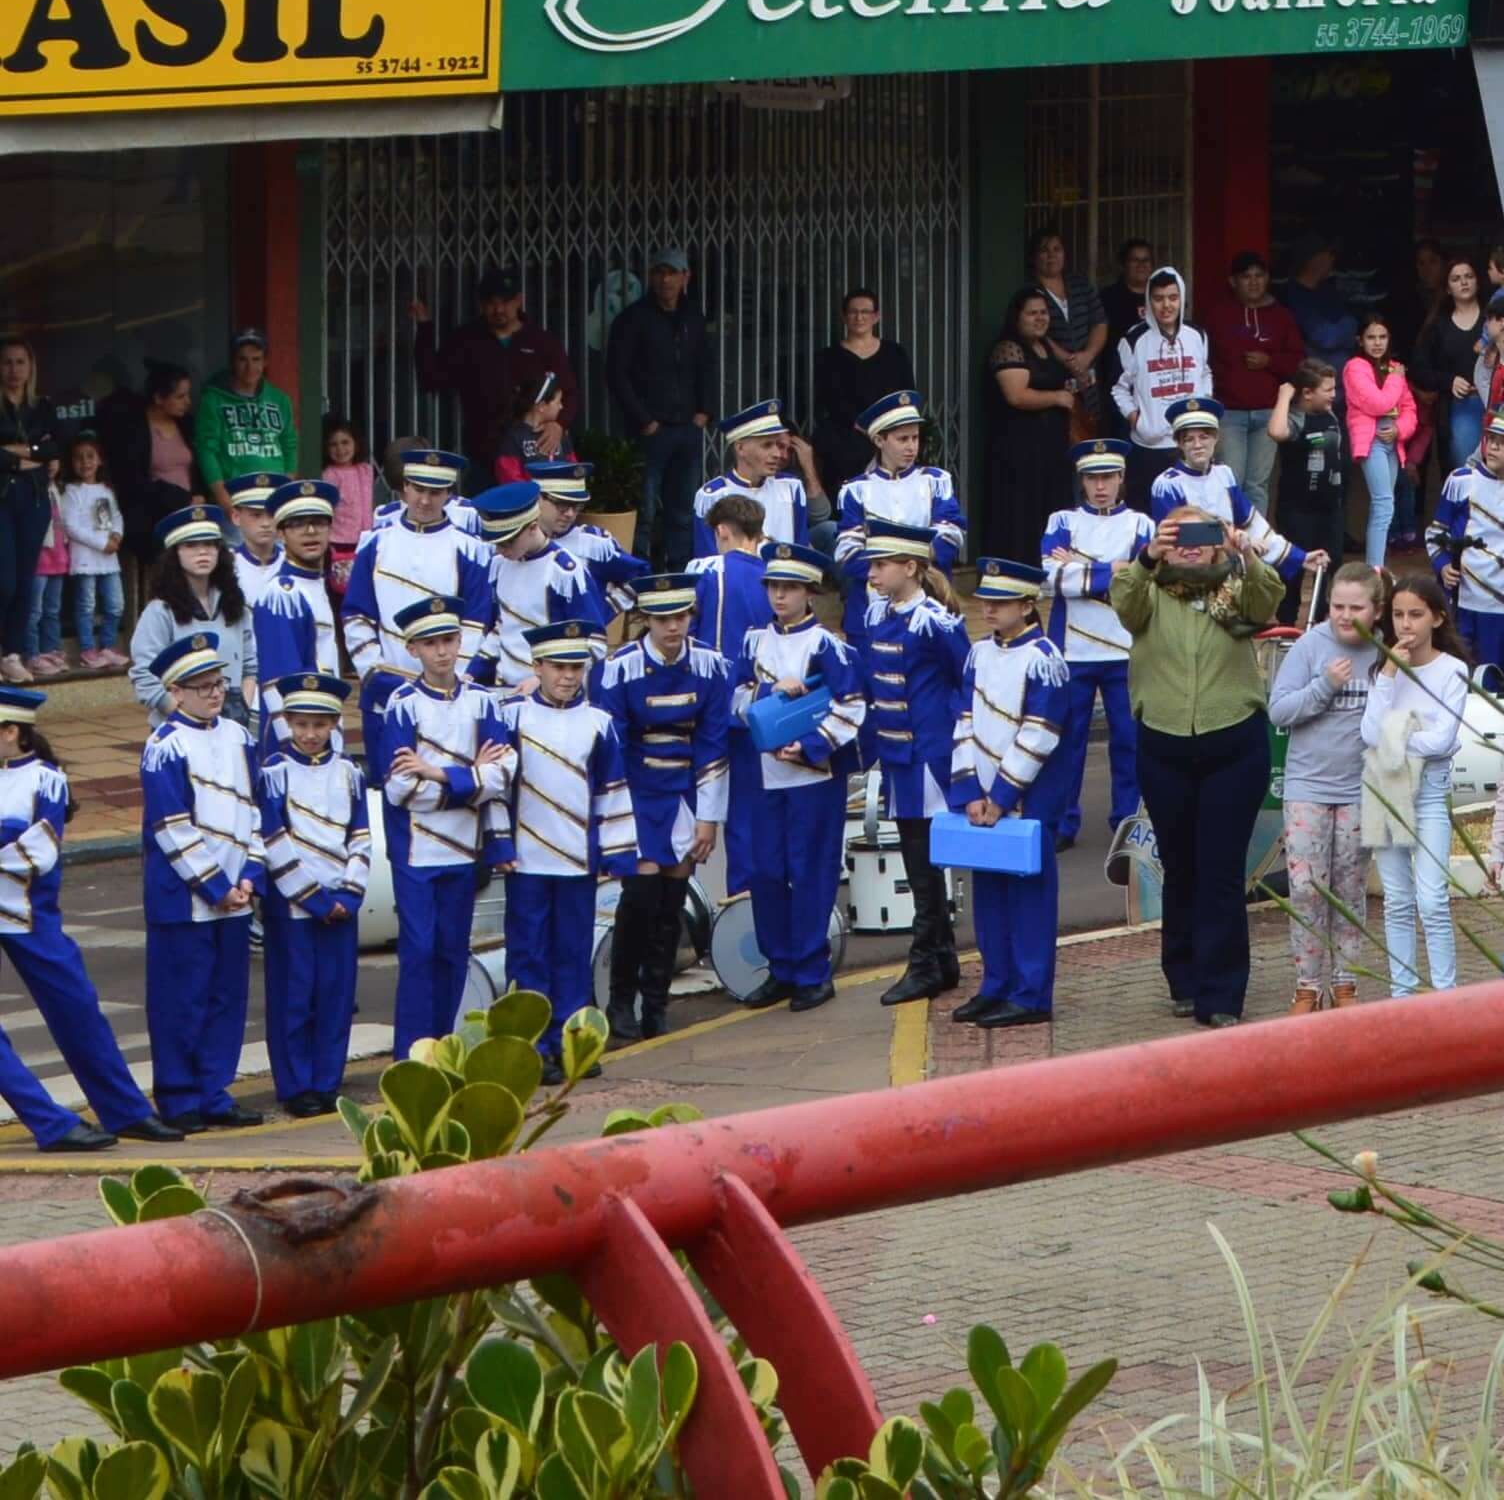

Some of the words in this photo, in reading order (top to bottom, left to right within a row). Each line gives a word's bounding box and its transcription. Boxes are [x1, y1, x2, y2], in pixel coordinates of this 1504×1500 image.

[1315, 23, 1340, 48] 55
[1344, 13, 1466, 48] 3744-1969
[356, 61, 374, 75] 55
[379, 56, 421, 74] 3744
[437, 55, 480, 72] 1922
